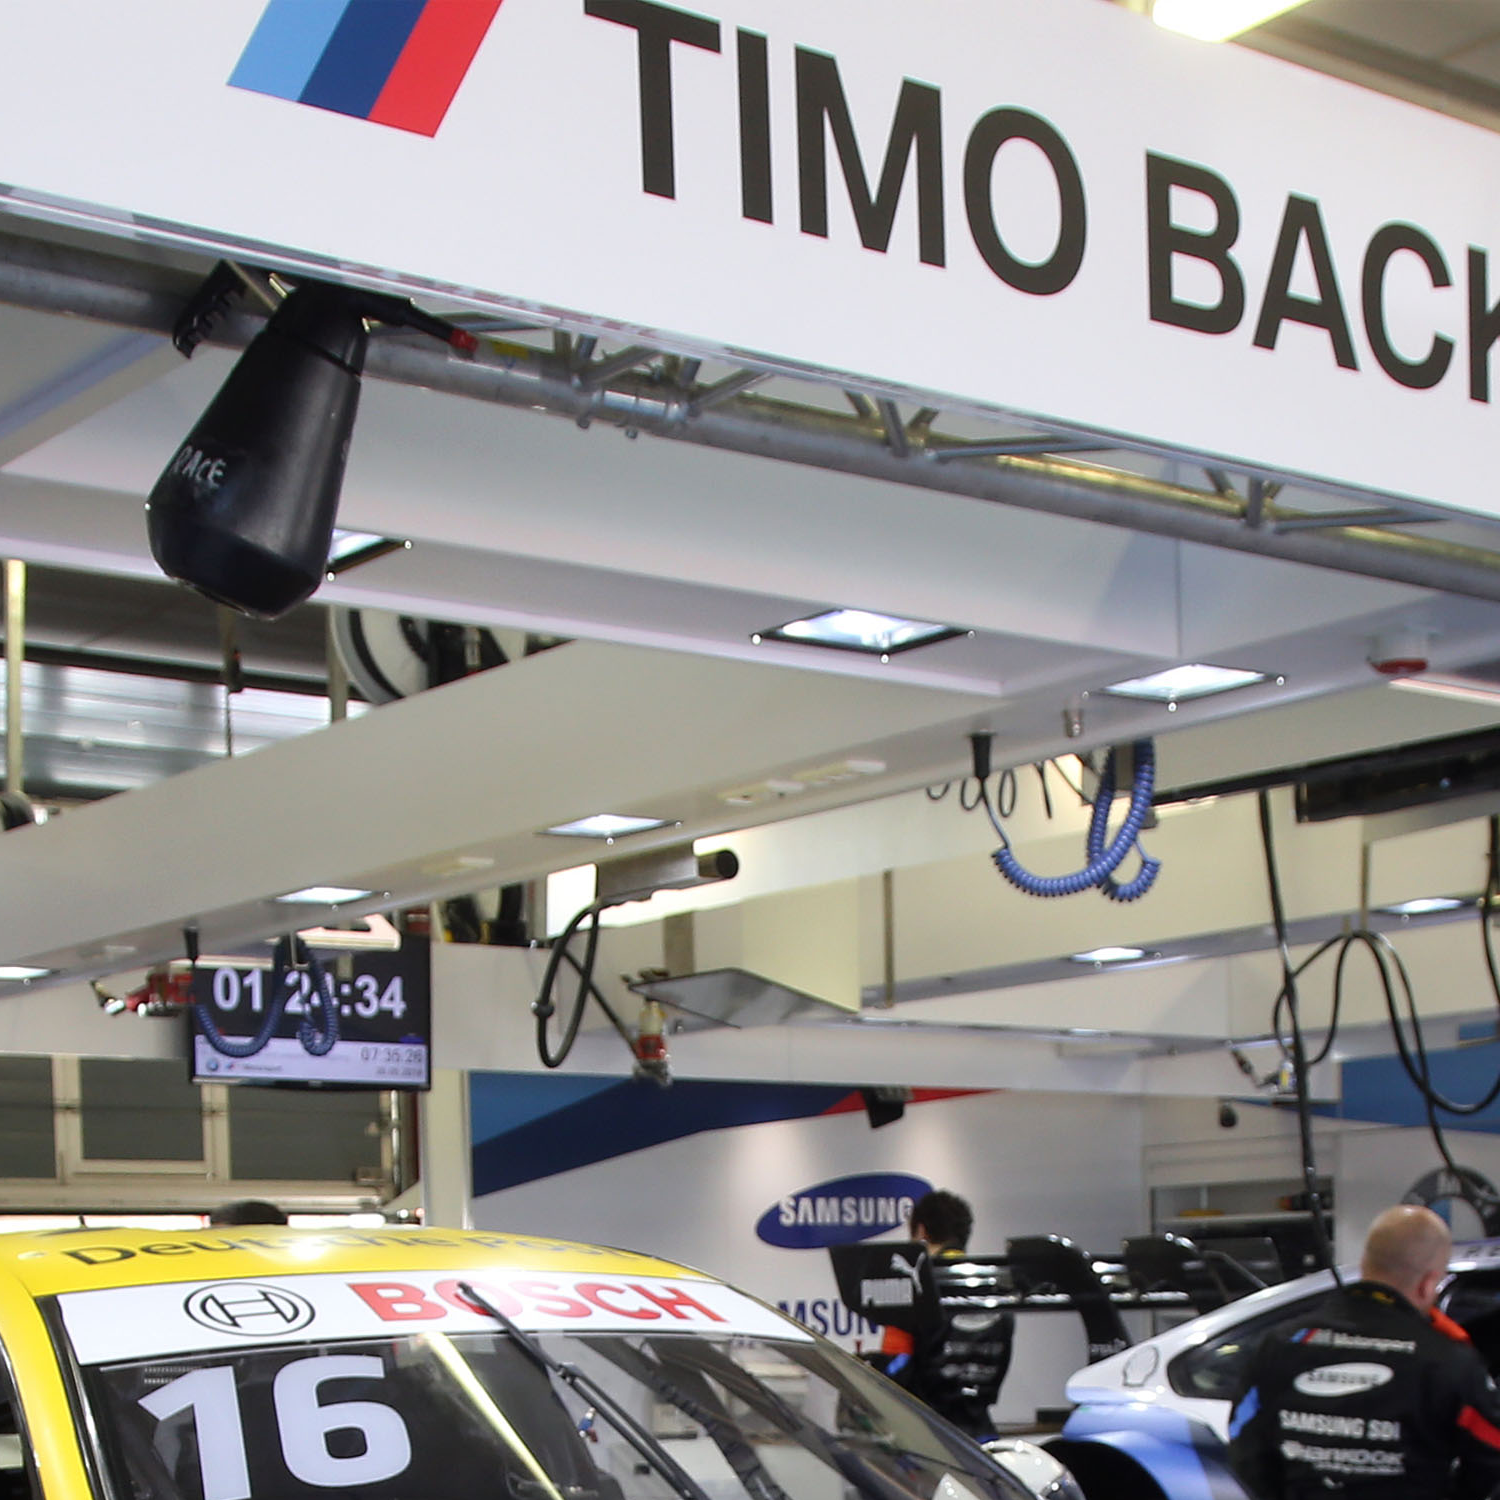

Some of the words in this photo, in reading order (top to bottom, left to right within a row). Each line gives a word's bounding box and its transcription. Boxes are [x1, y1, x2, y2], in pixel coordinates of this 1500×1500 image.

[582, 0, 1088, 297] TIMO
[778, 1196, 915, 1227] SAMSUNG
[347, 1280, 730, 1323] BOSCH
[1279, 1409, 1364, 1439] SAMSUNG
[1367, 1418, 1401, 1441] SDI
